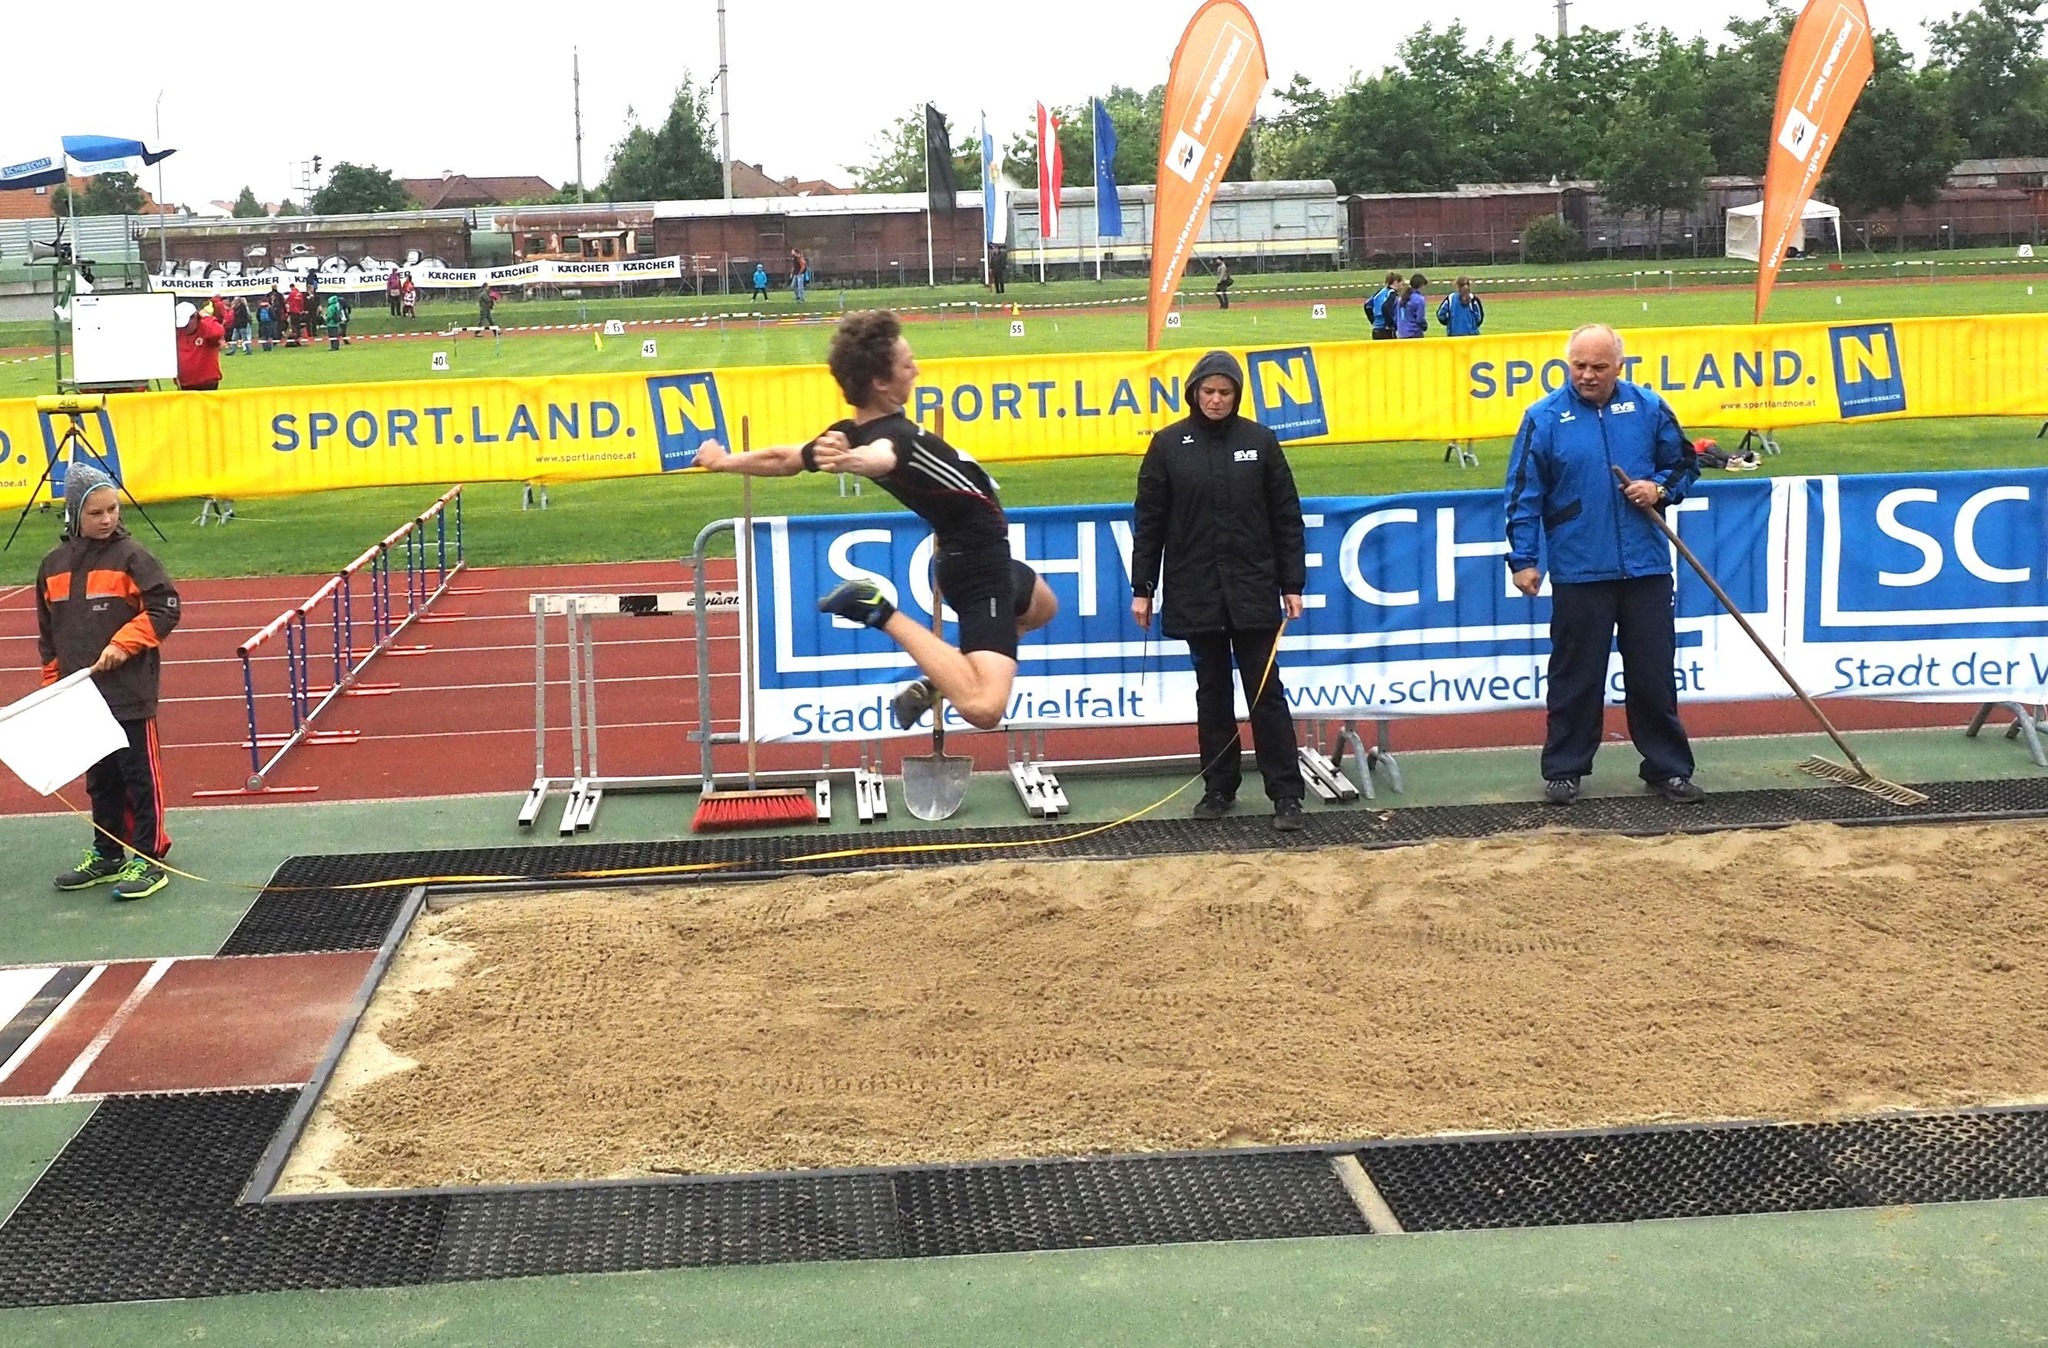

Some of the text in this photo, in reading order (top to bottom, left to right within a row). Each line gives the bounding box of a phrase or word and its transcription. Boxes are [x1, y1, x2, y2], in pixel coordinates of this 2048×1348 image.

[294, 275, 346, 285] KÄCHER
[359, 270, 411, 283] KÄRCER
[1314, 308, 1325, 316] 65
[1168, 316, 1179, 325] 60
[1012, 325, 1022, 333] 55
[643, 344, 655, 353] 45
[433, 356, 444, 366] 40
[1470, 350, 1816, 399] SPOT.LAND.
[915, 377, 1180, 423] PORT.LAN
[1610, 401, 1635, 412] SVS
[272, 401, 636, 452] SPORT.LAND.
[535, 451, 637, 464] www.sportlandnoe.at
[1233, 449, 1258, 460] SVS
[827, 497, 1709, 630] SCHECHT
[1835, 653, 1941, 690] Stadt
[1951, 652, 2020, 686] der
